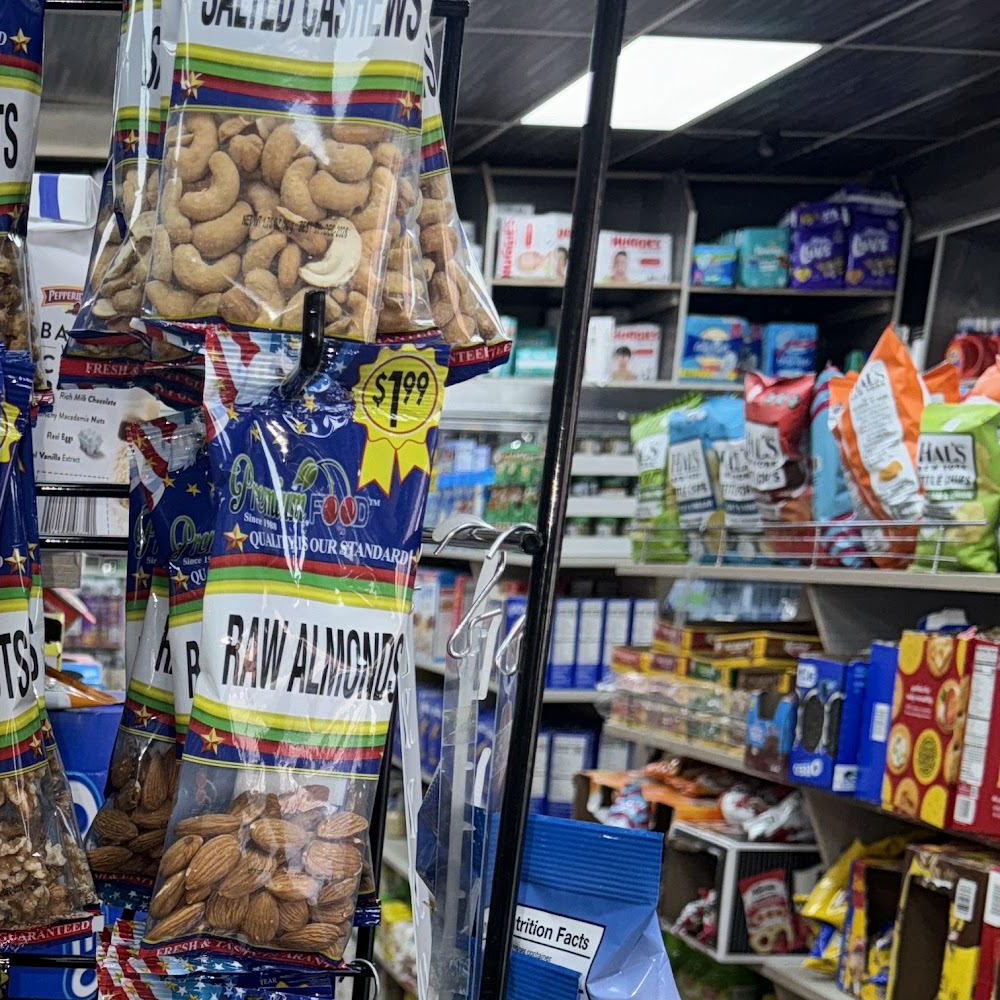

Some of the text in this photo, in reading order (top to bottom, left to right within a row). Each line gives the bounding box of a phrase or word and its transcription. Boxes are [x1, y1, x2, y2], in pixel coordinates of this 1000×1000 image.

[297, 0, 421, 41] CASHEWS
[85, 362, 128, 376] FRESH
[88, 395, 117, 407] Chocolate
[229, 454, 370, 529] Premium FOOD
[243, 511, 262, 526] Since
[310, 537, 338, 555] OUR
[340, 540, 410, 566] STANDARD
[222, 613, 290, 691] RAW
[287, 622, 405, 704] ALMONDS
[156, 938, 212, 956] FRESH &
[555, 926, 591, 951] Facts
